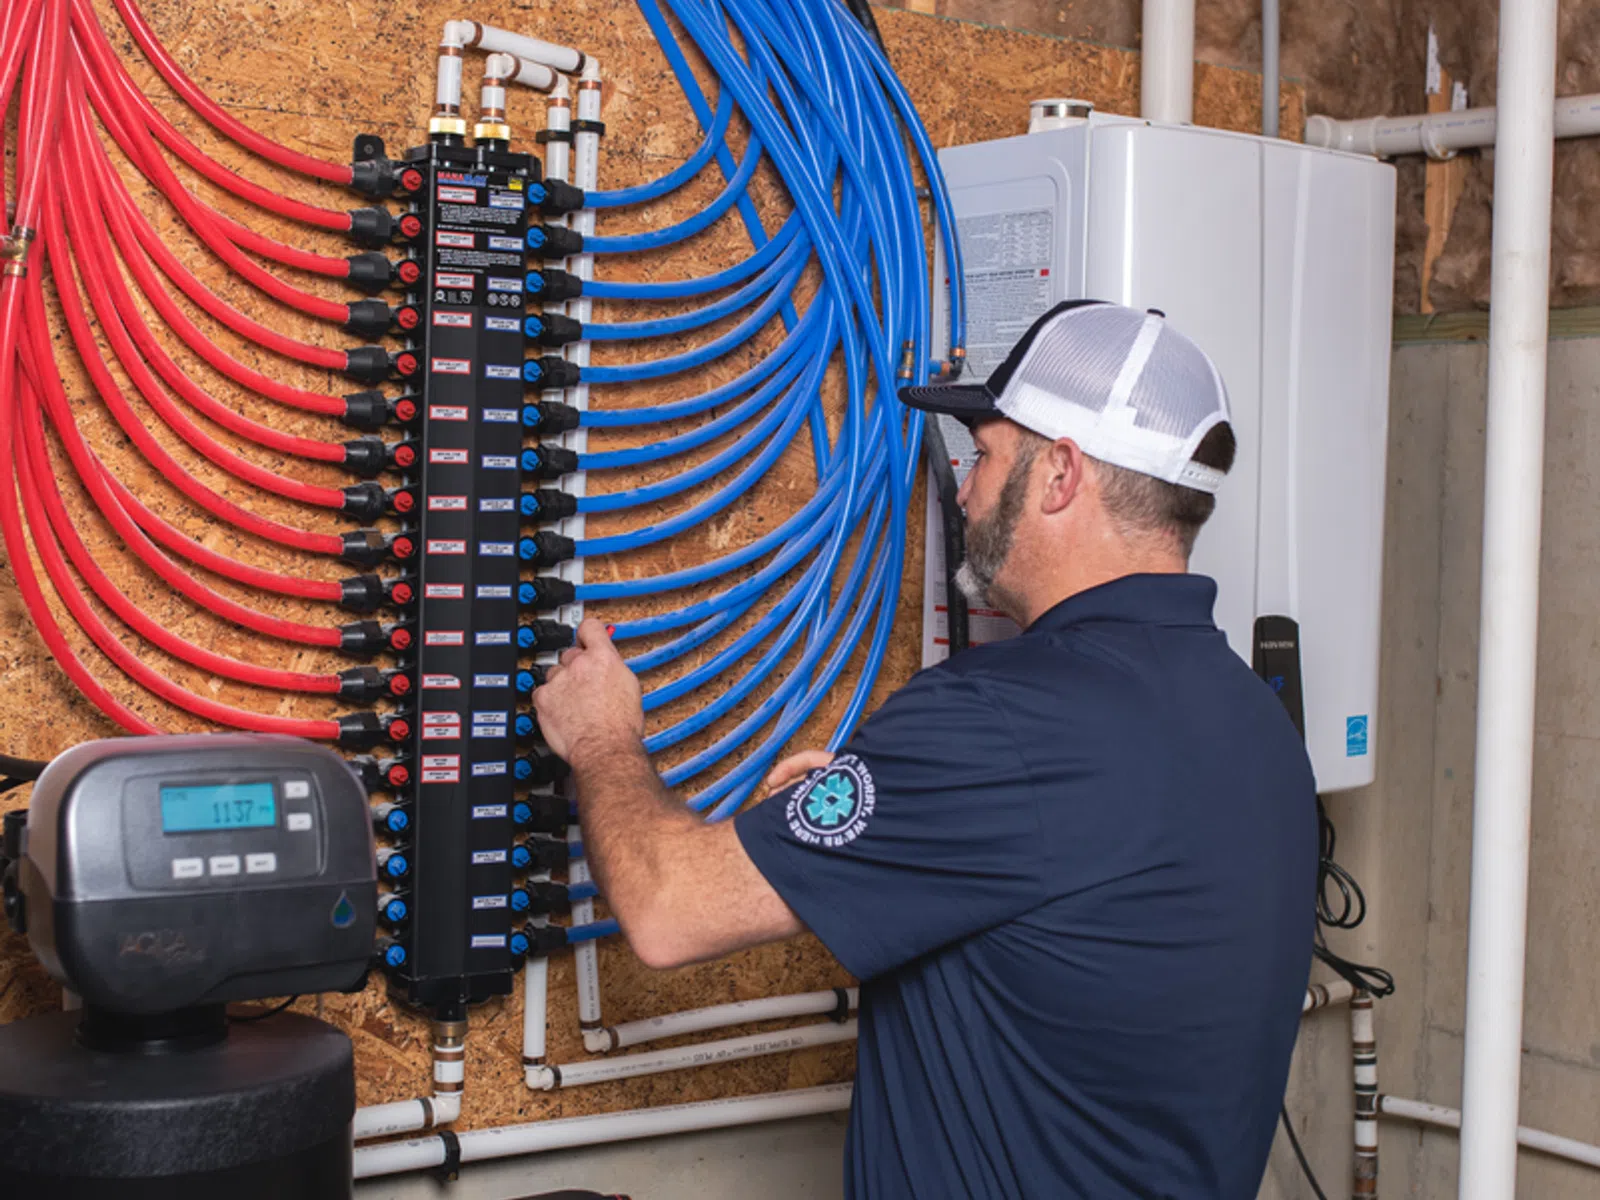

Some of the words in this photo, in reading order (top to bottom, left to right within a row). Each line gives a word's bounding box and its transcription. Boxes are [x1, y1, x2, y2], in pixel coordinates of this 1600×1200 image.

[857, 761, 876, 816] WORRY,
[788, 819, 820, 846] HERE
[822, 820, 867, 847] WE'RE
